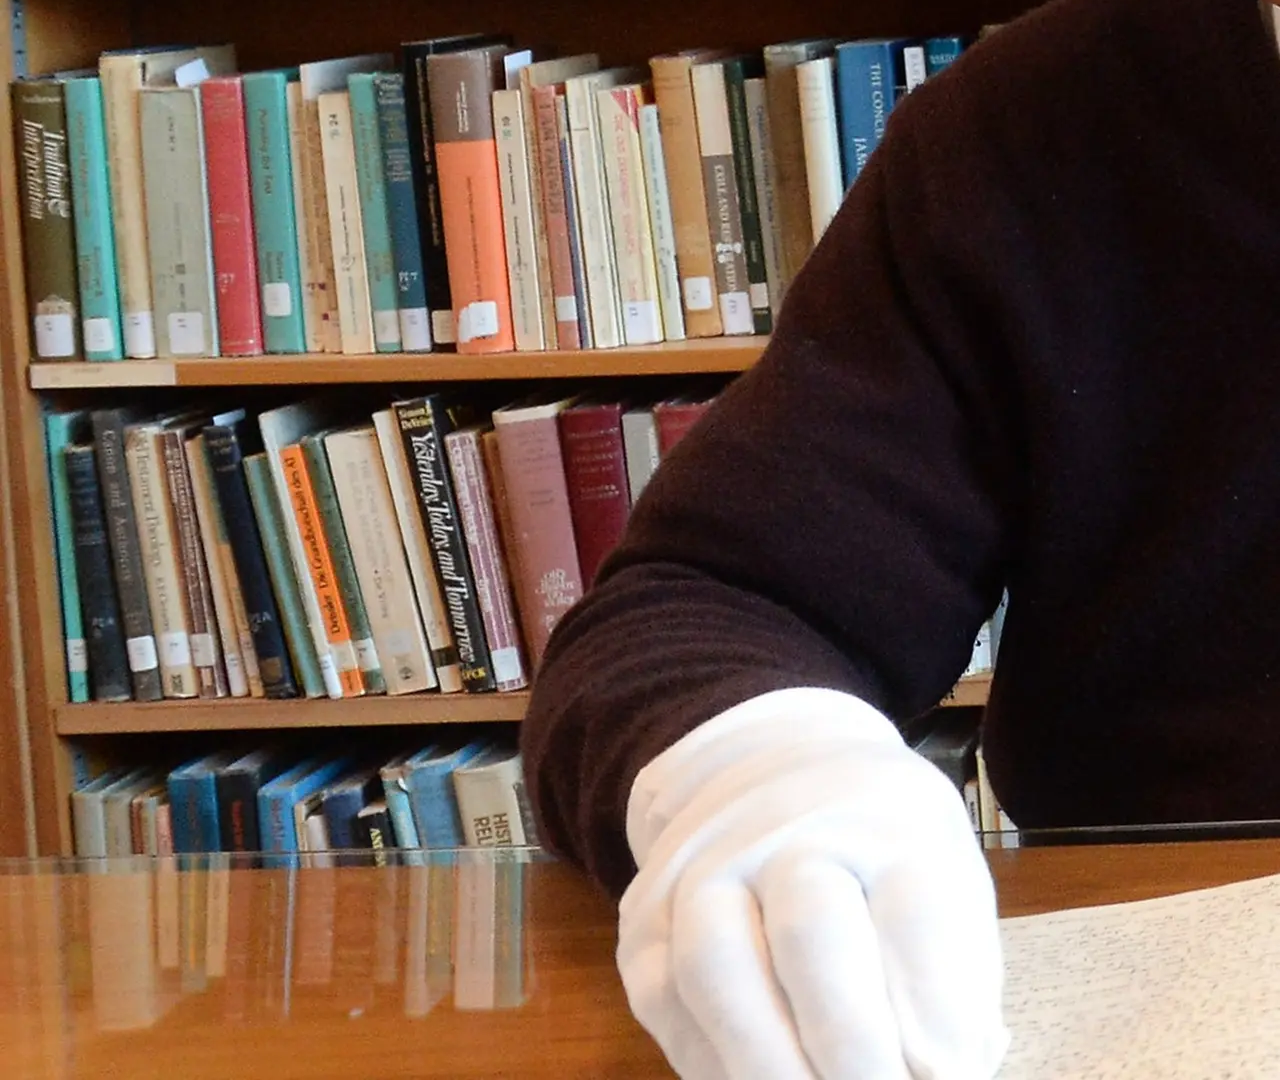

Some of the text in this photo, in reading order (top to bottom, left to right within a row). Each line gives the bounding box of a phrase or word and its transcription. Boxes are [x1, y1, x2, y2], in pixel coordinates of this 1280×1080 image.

[869, 64, 883, 87] THE
[21, 119, 43, 220] Interpretation
[43, 129, 66, 197] Tradition
[436, 551, 459, 581] and
[445, 580, 478, 663] Tomorrow
